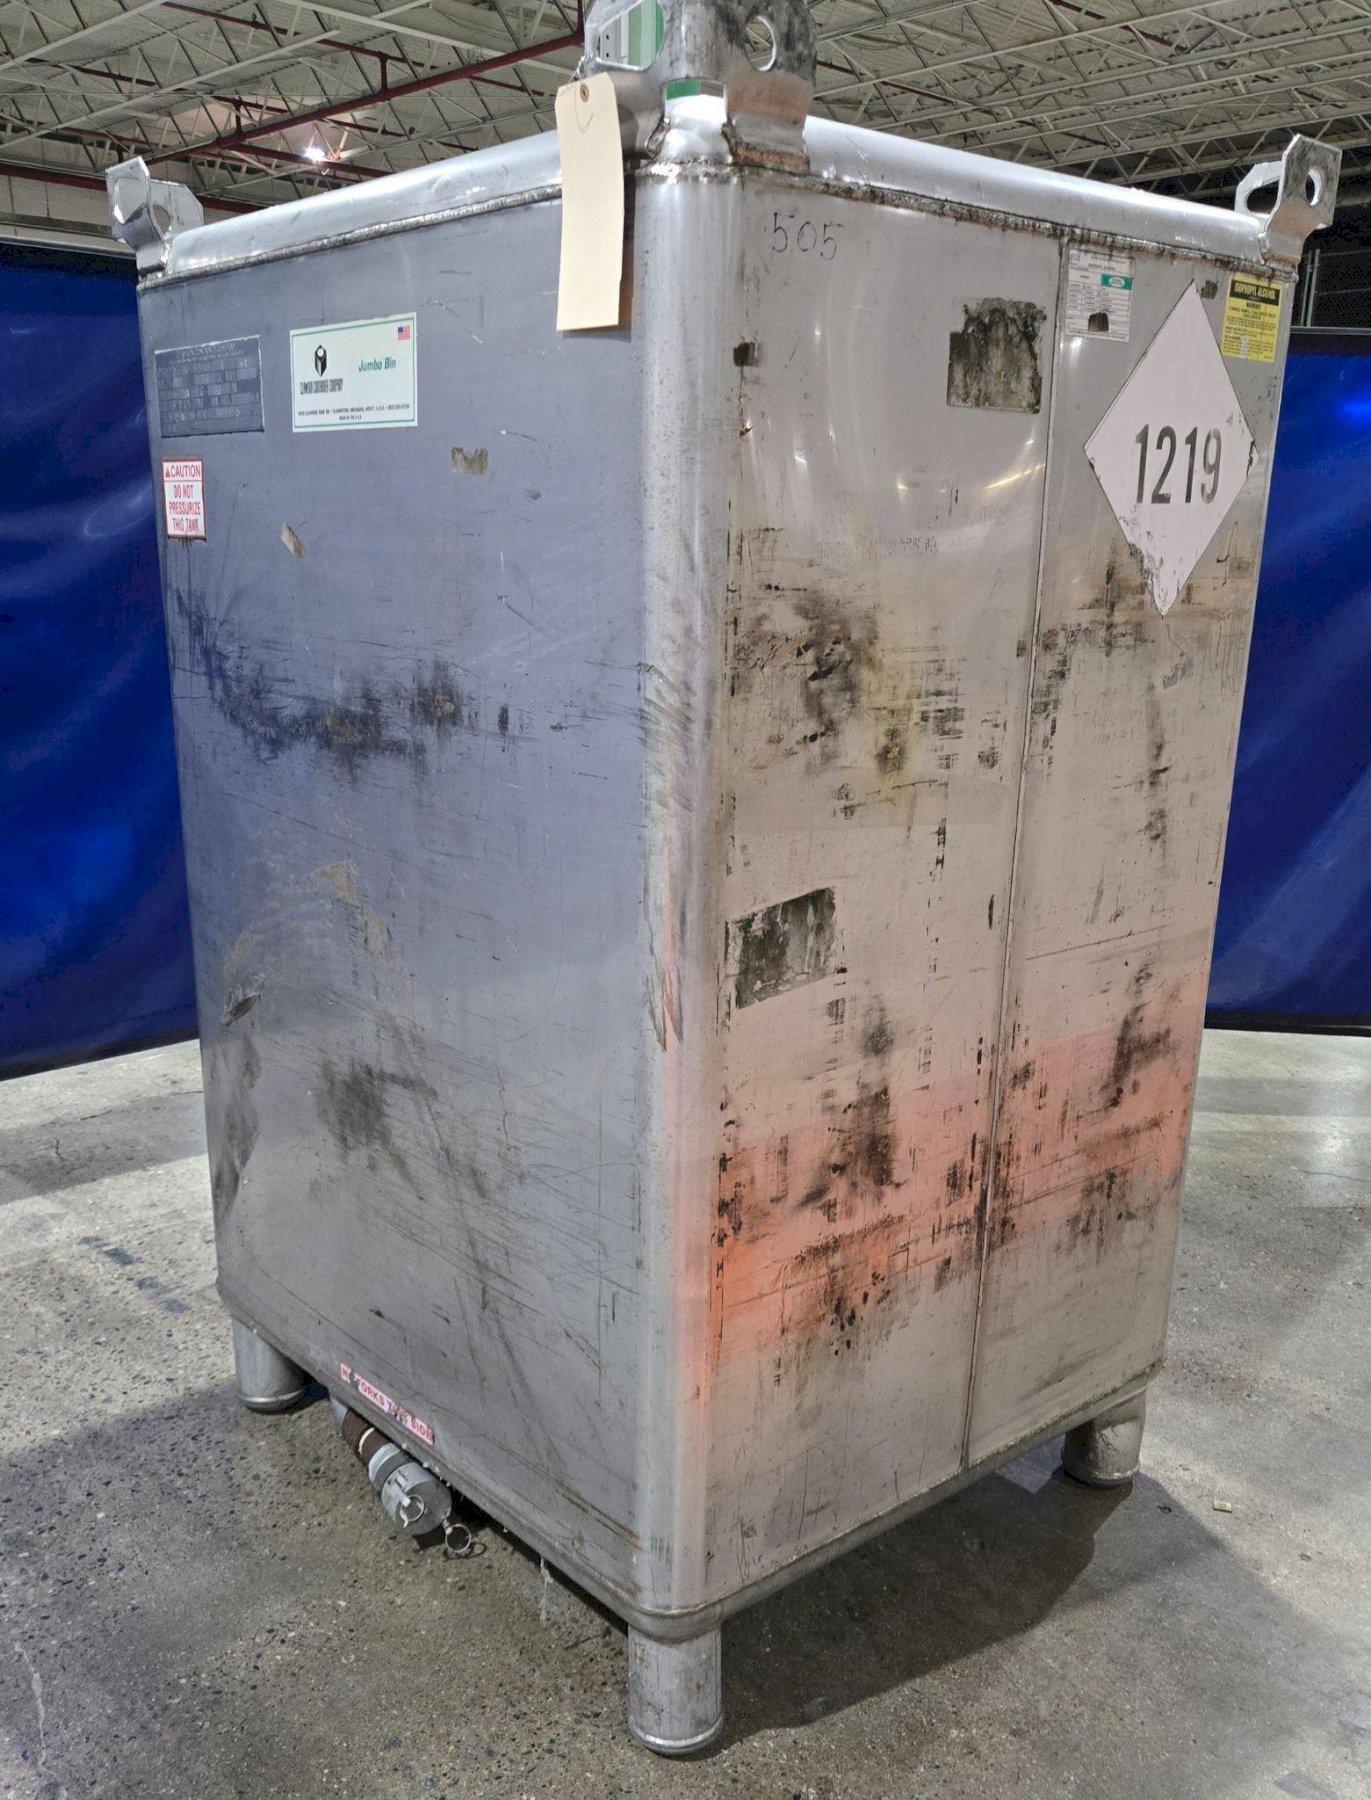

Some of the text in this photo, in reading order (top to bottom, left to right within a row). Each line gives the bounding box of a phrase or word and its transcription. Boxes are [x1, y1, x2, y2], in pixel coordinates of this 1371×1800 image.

[772, 212, 845, 260] 505
[358, 356, 396, 372] Jumbo Bin
[170, 464, 201, 478] CAUTION
[1135, 424, 1222, 504] 1219
[173, 484, 194, 498] DO NOT
[169, 502, 201, 516] PRESSURIZE
[172, 517, 199, 533] THIS TANK
